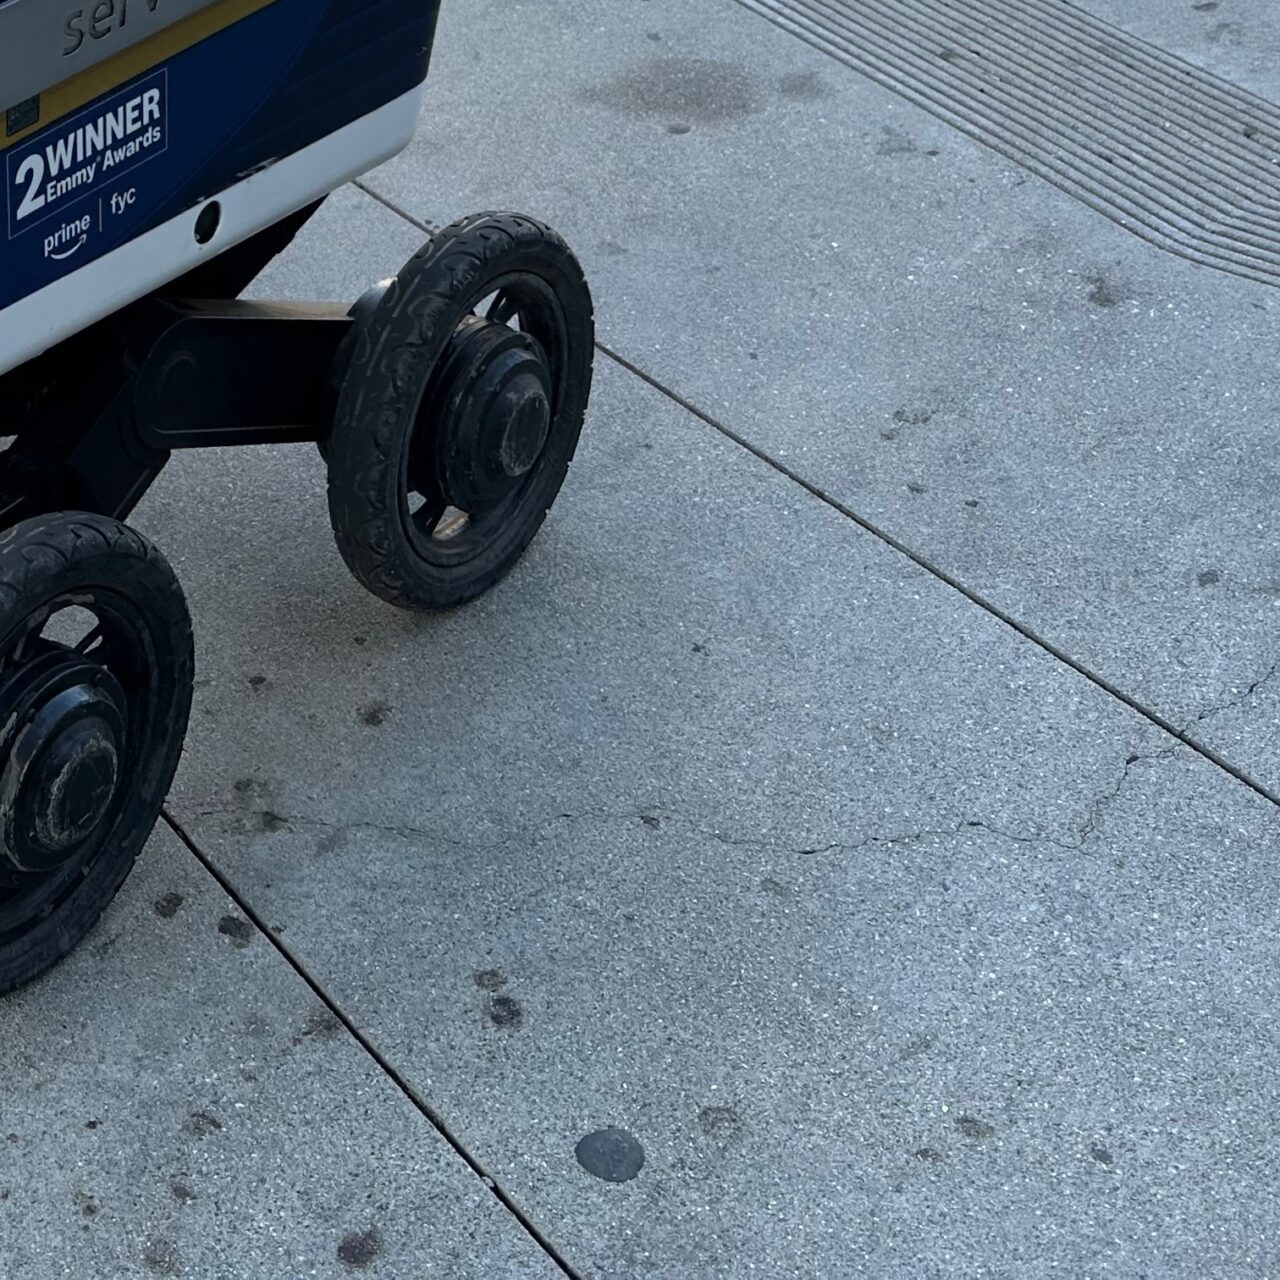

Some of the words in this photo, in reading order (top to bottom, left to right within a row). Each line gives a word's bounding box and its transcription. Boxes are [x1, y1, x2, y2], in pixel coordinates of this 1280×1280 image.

[45, 87, 161, 177] WINNER
[102, 126, 161, 171] Awards
[44, 214, 91, 258] prime
[110, 187, 136, 214] fyc
